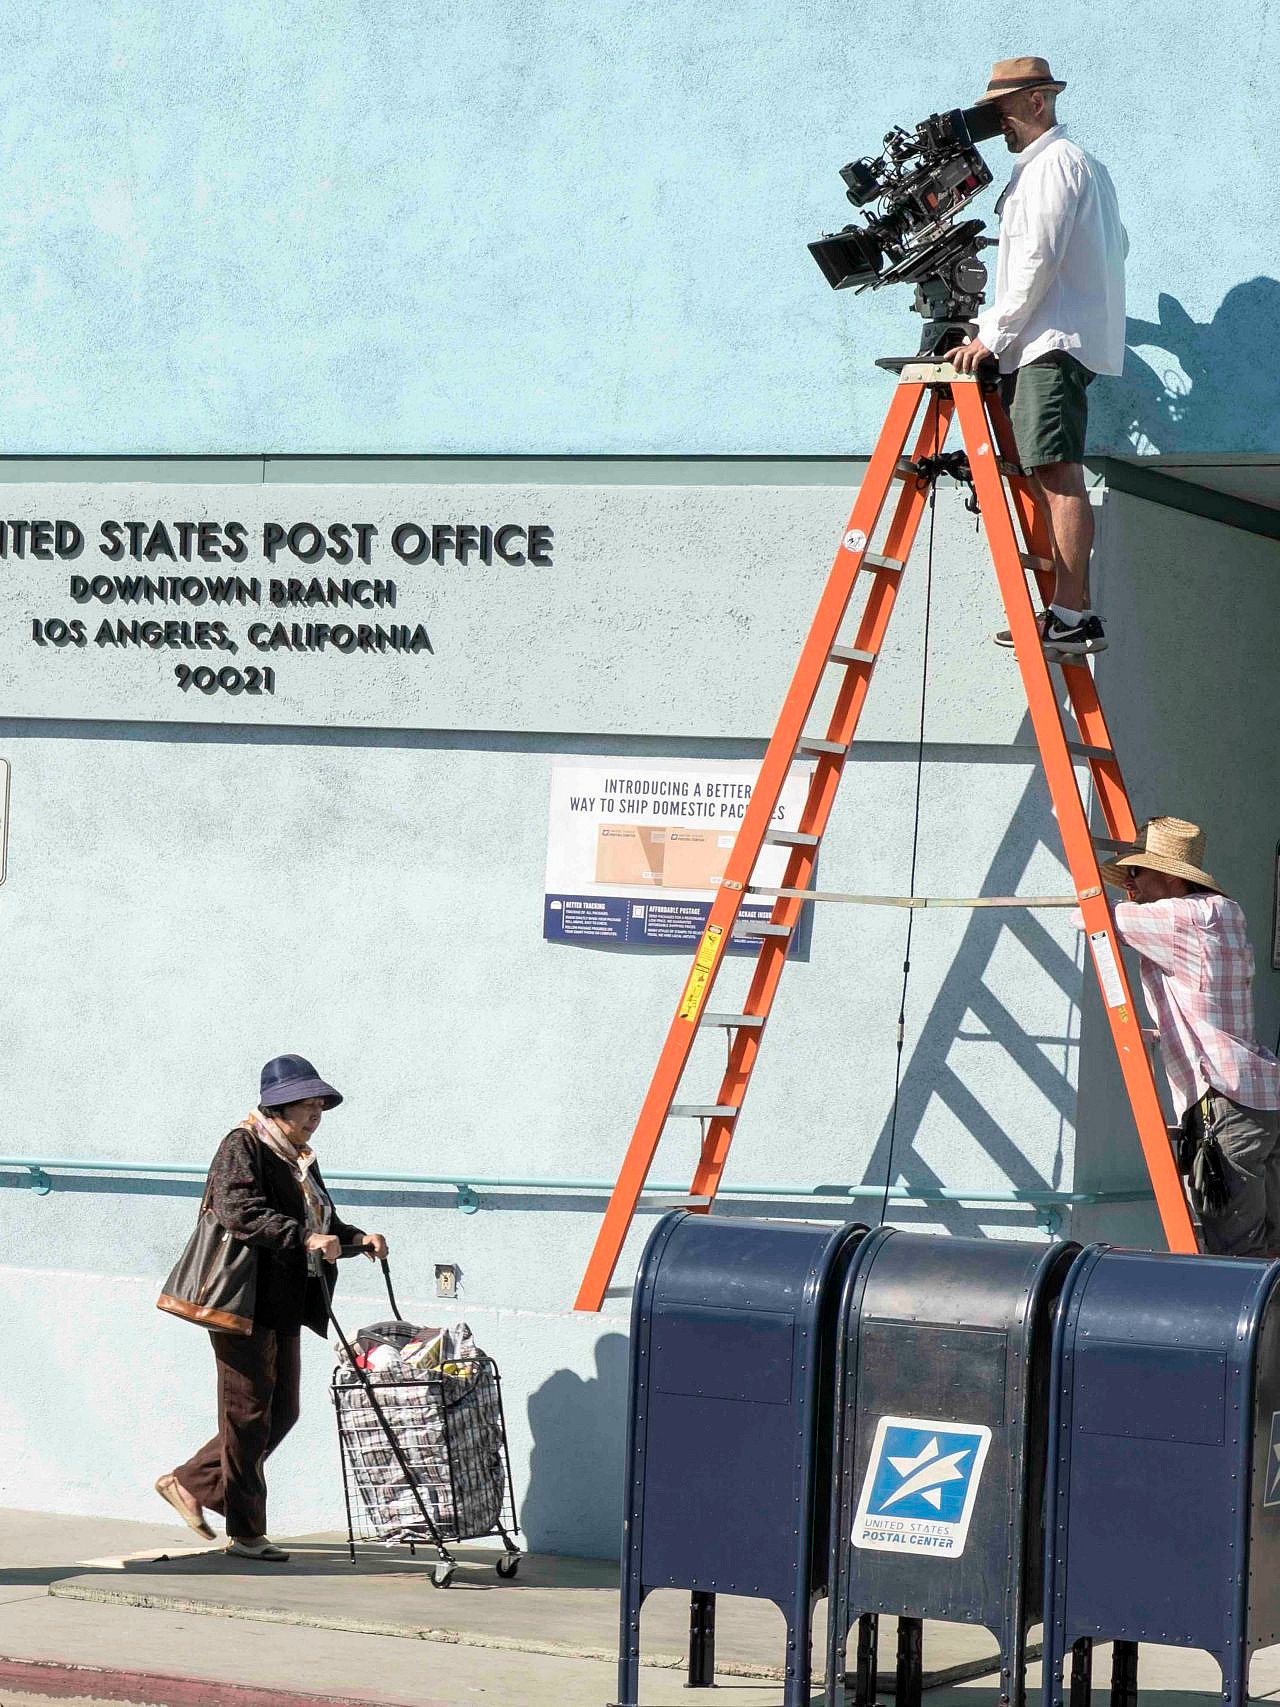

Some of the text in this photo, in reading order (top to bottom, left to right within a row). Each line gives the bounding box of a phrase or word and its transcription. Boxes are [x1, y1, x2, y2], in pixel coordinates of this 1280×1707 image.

[99, 521, 249, 562] STATES
[263, 523, 374, 563] POST
[392, 524, 552, 566] OFFICE
[71, 575, 396, 608] DOWNTOWN BRANCH
[32, 619, 434, 655] LOS ANGELES, CALIFORNIA
[174, 664, 275, 695] 90021
[605, 779, 751, 799] INTRODUCING A BETTER
[570, 797, 595, 811] WAY
[601, 798, 614, 812] TO
[619, 799, 648, 815] SHIP
[653, 800, 715, 817] DOMESTIC
[680, 907, 700, 915] POSTAGE
[865, 1519, 950, 1535] UNITED STATES
[863, 1531, 953, 1548] POSTAL CENTER
